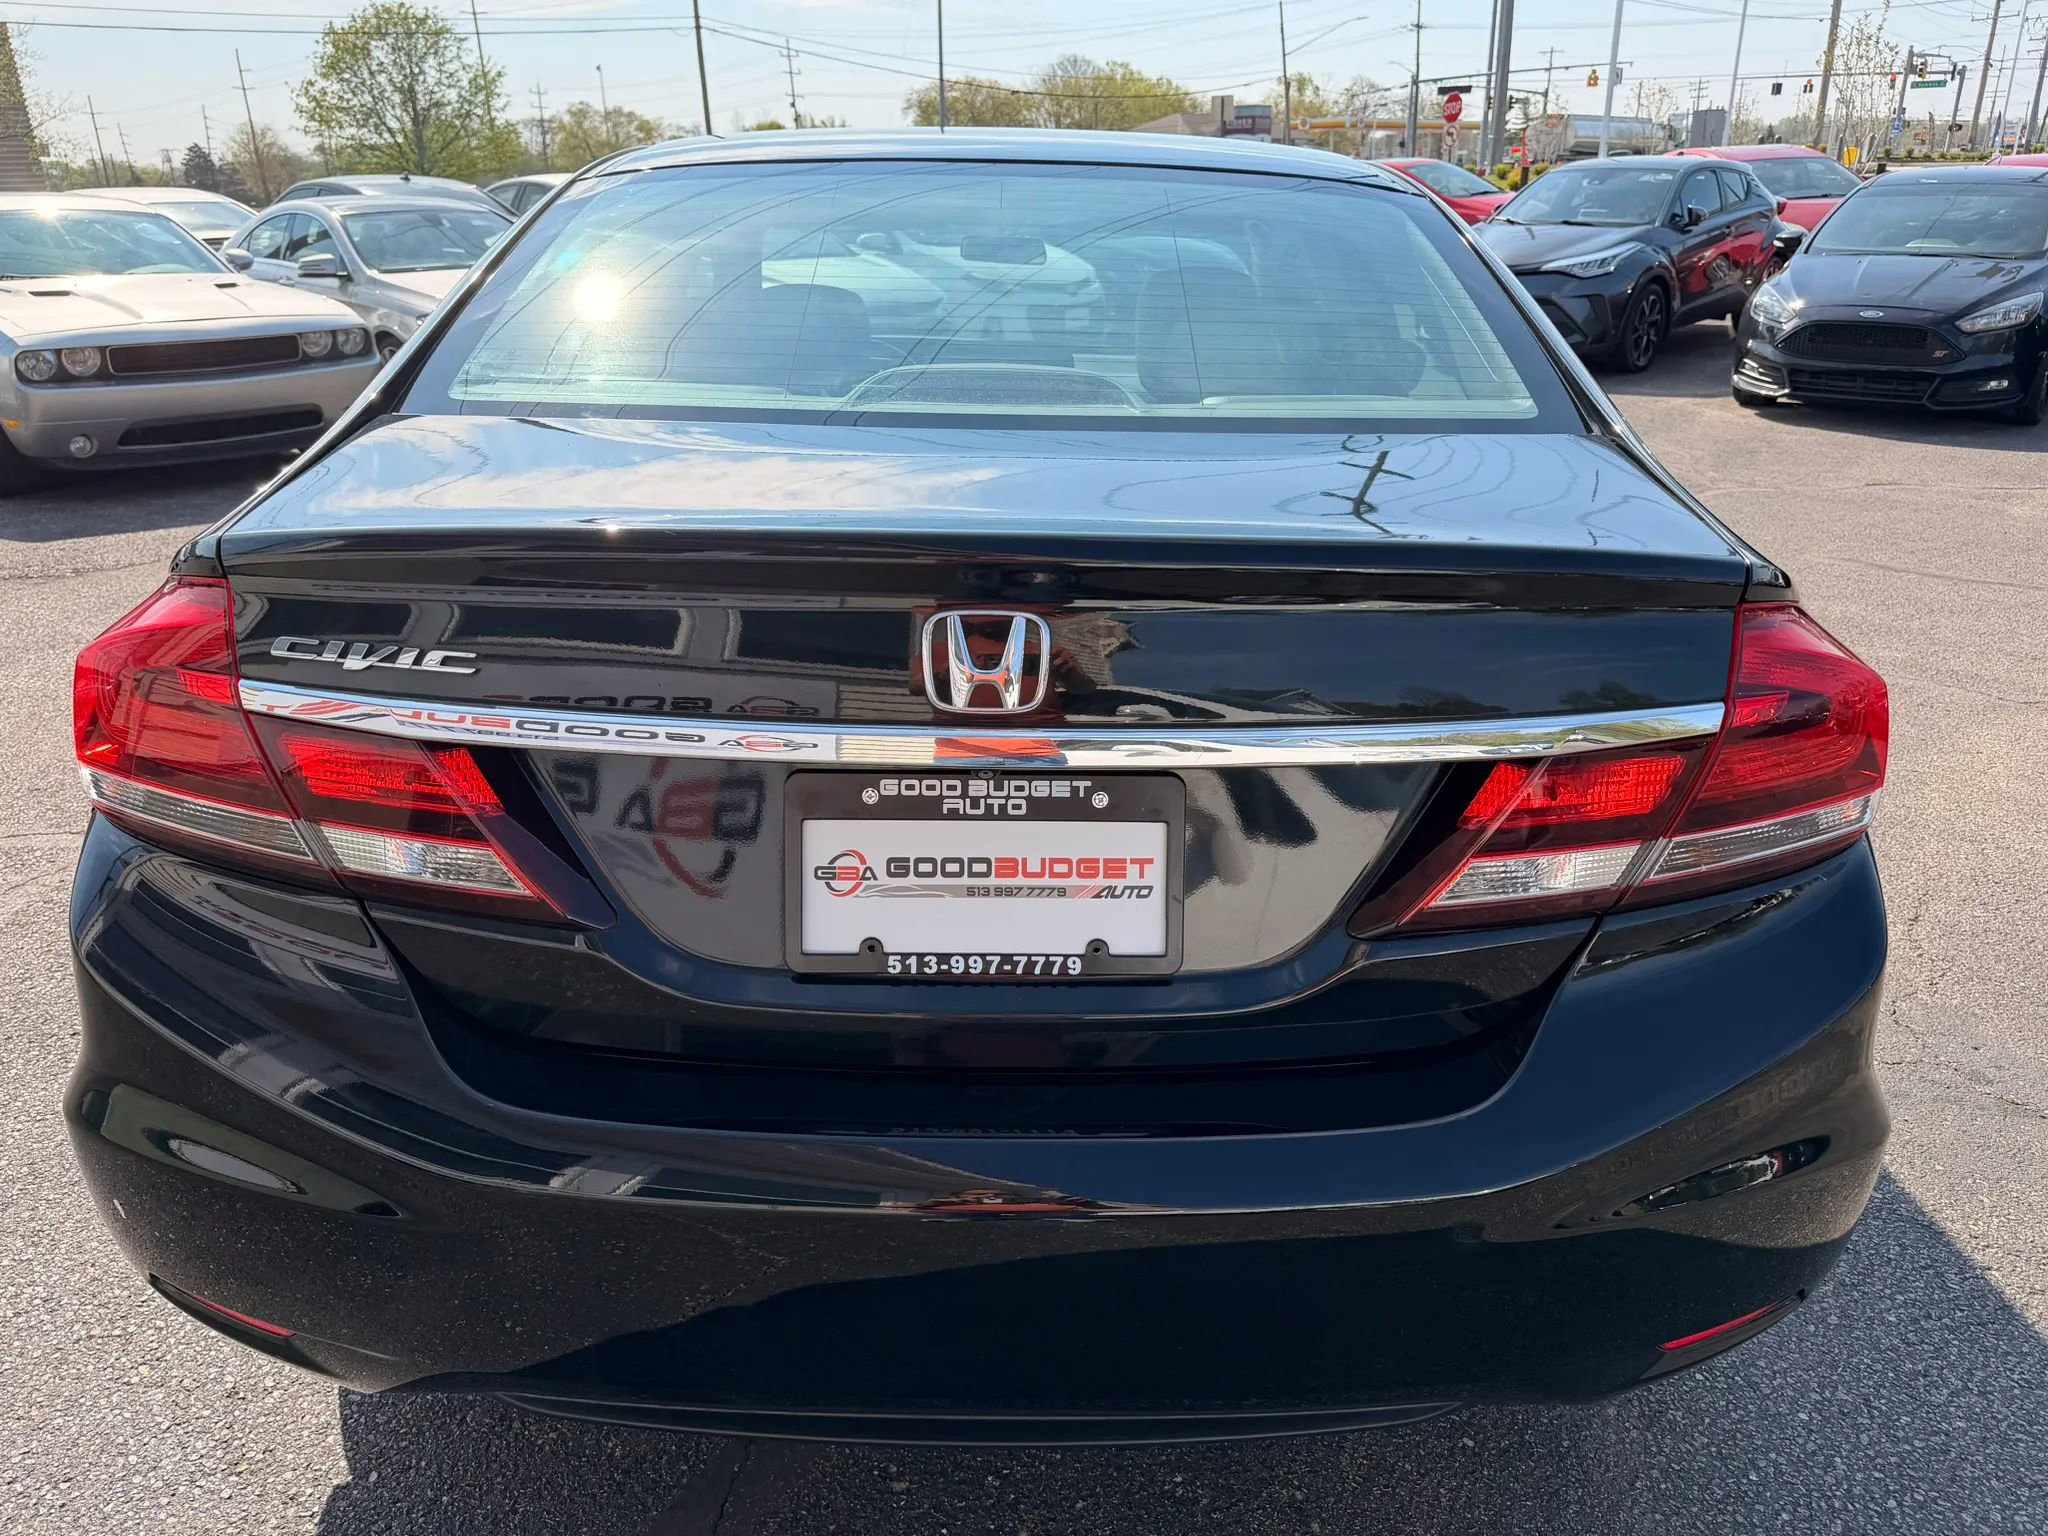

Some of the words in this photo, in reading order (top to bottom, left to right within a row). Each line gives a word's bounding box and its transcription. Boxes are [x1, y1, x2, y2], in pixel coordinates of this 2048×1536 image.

[1443, 101, 1461, 116] STOP
[1931, 350, 1949, 358] ST
[270, 636, 477, 674] CIVIC
[879, 778, 962, 796] GOOD
[967, 780, 1092, 798] BUDGET
[942, 798, 1027, 815] AUTO
[813, 865, 879, 881] GBA
[966, 886, 991, 897] 513
[994, 886, 1025, 897] 997
[1025, 886, 1067, 897] 7779
[1092, 885, 1154, 899] AUTO
[887, 954, 1083, 976] 513-997-7779
